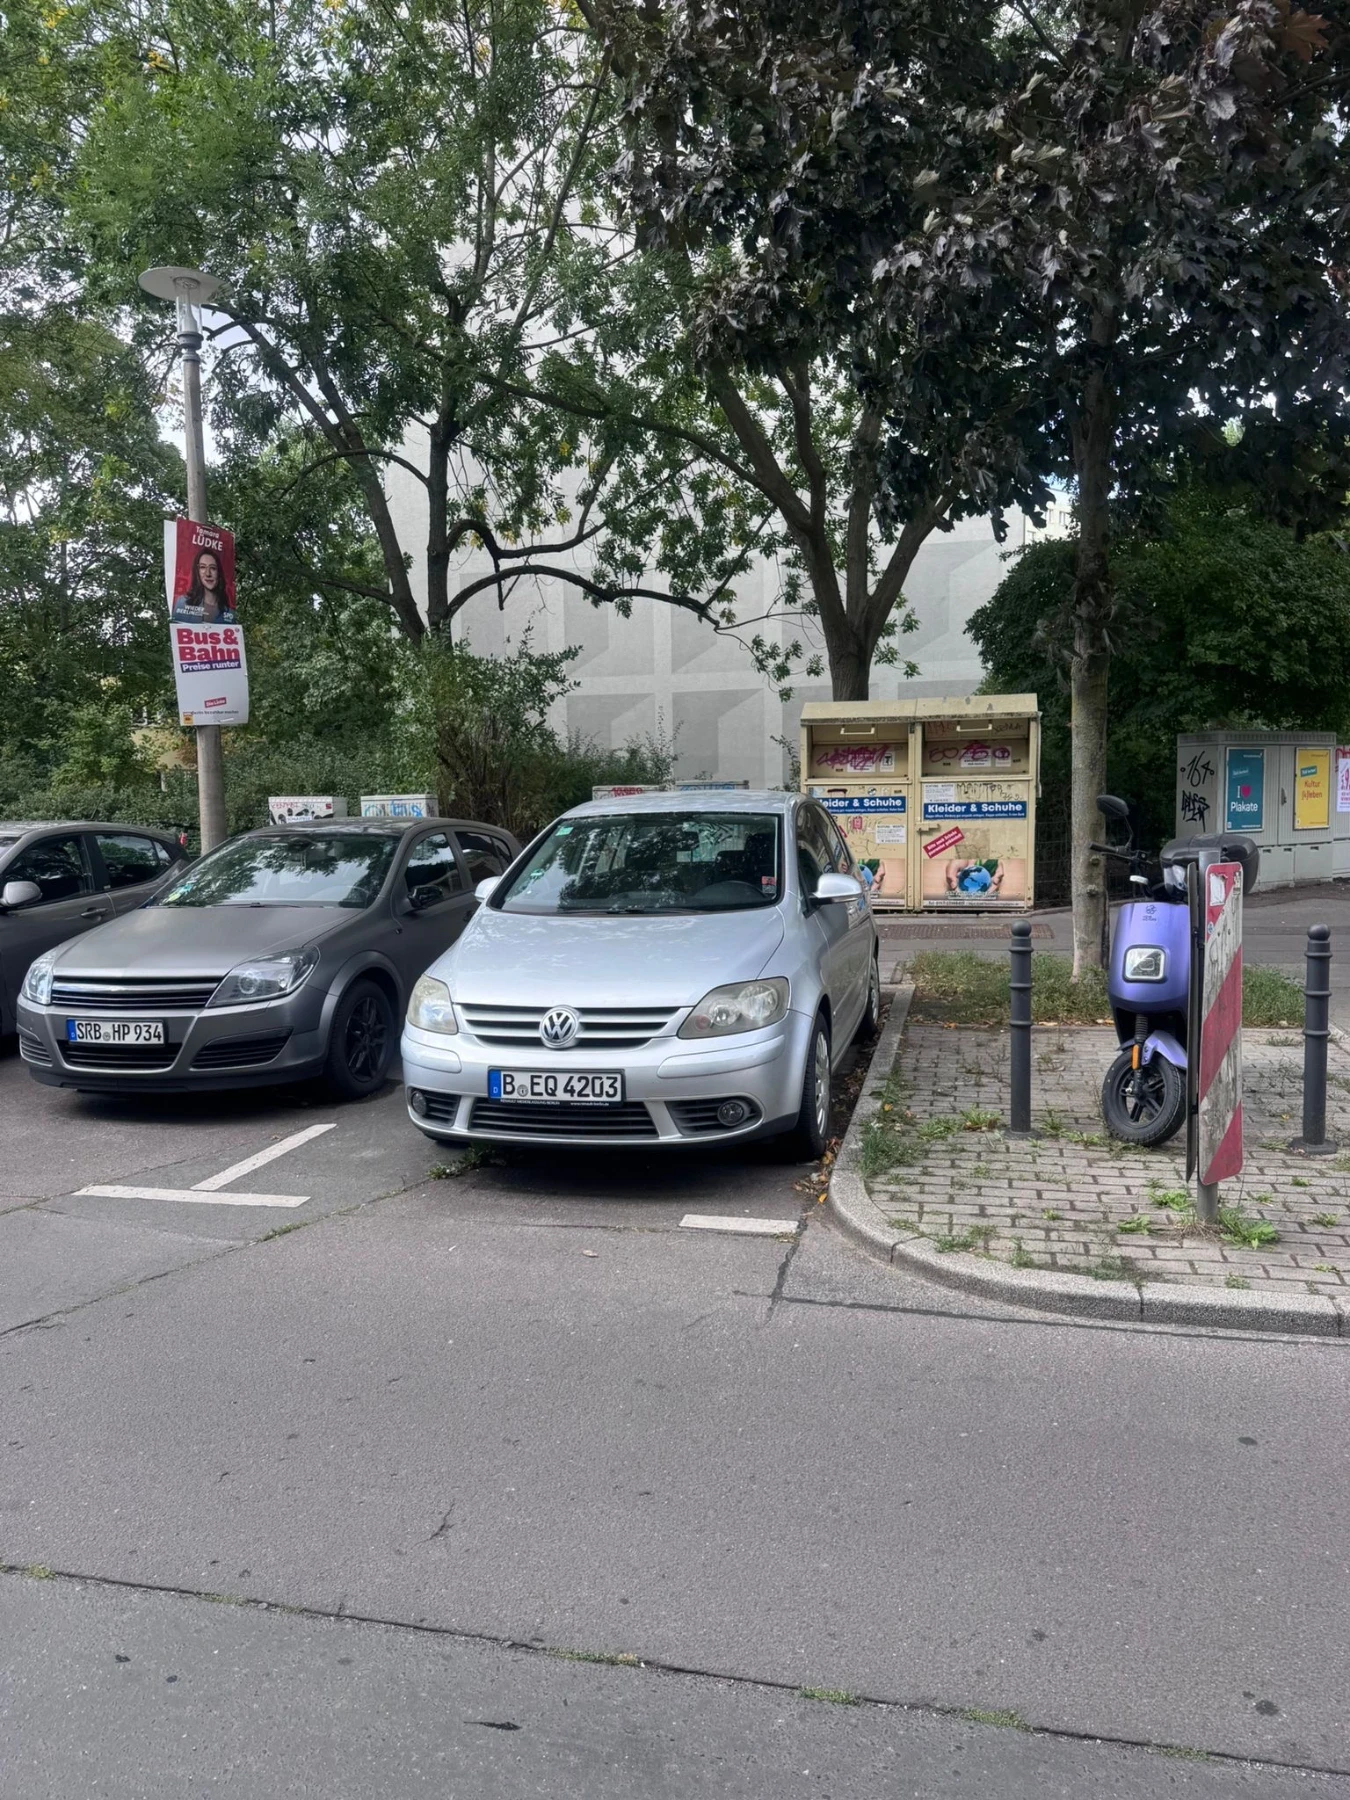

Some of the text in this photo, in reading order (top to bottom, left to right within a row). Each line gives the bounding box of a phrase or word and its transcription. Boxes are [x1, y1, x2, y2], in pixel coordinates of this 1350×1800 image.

[196, 526, 220, 538] Tamara
[192, 534, 223, 551] LÜDKE
[178, 646, 240, 661] Bahn
[182, 661, 239, 672] Preise runter
[1304, 780, 1321, 788] Kultur
[1236, 786, 1241, 798] I
[820, 798, 902, 807] eider & Schuhe
[928, 804, 1022, 813] Kleider & Schuhe
[1230, 802, 1258, 812] Plakate
[76, 1022, 162, 1042] SRB HP 934
[502, 1074, 618, 1098] B EQ 4203
